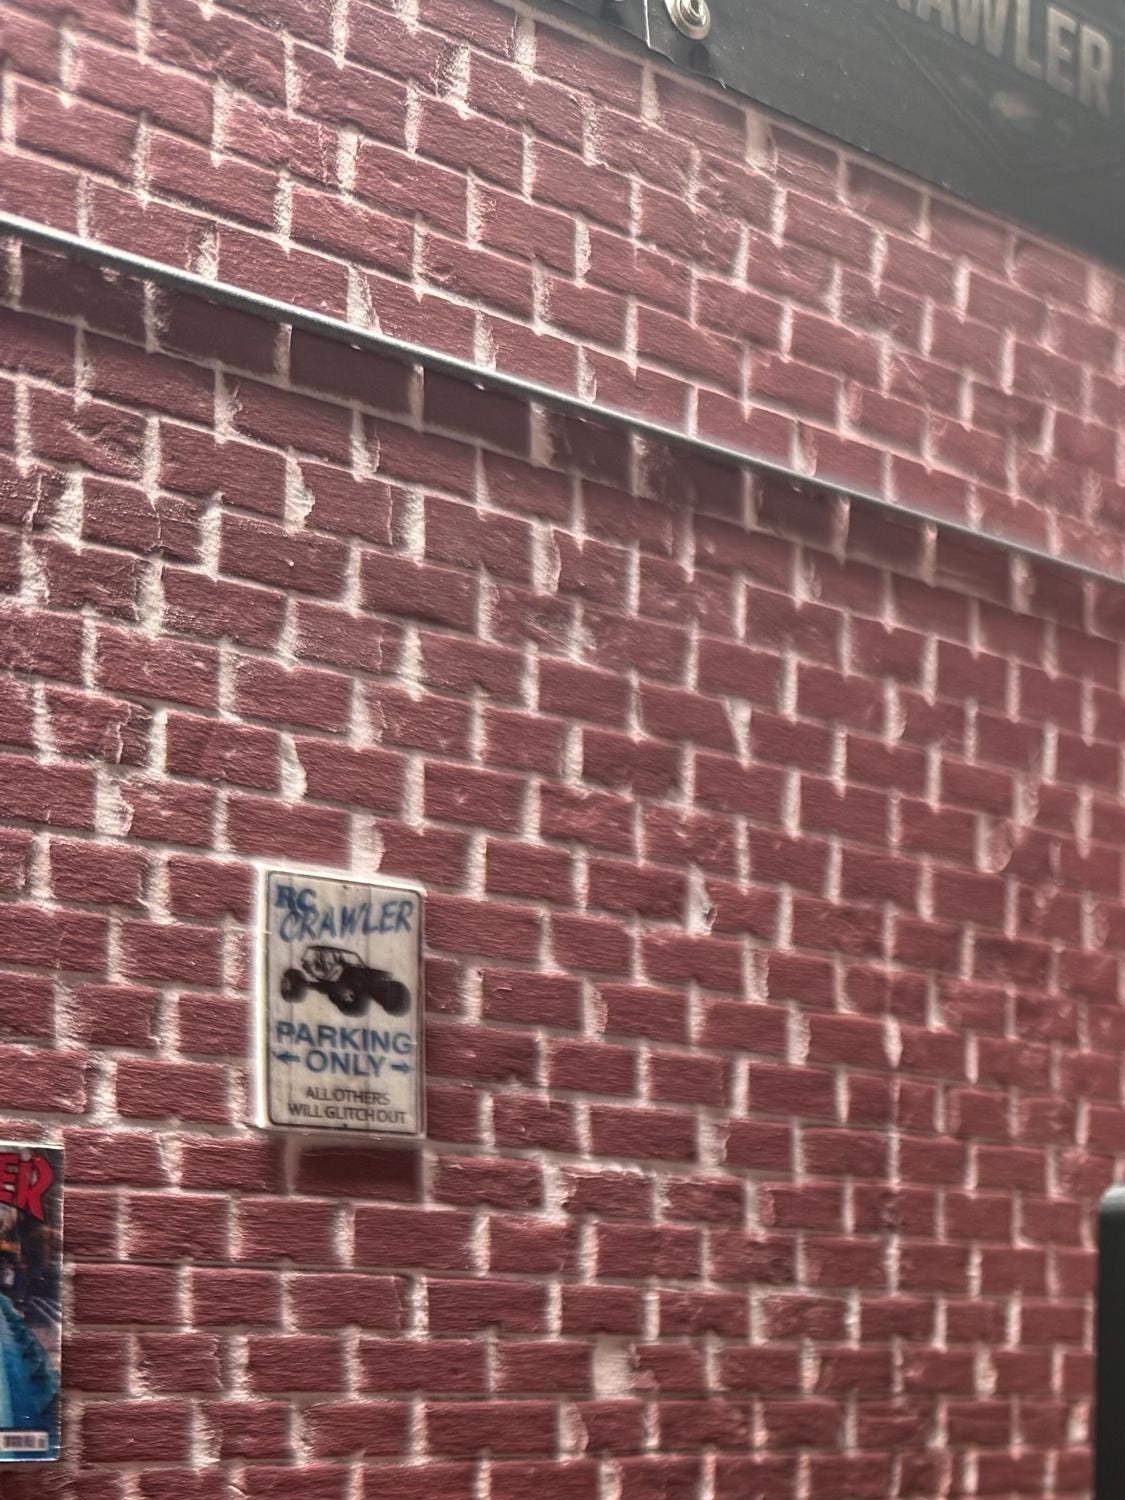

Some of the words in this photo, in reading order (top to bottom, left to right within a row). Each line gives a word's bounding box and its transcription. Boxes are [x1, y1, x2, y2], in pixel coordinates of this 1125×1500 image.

[274, 884, 318, 918] RC
[279, 900, 415, 942] CRAWLER
[276, 1021, 413, 1055] PARKING
[305, 1050, 387, 1078] ONLY
[305, 1086, 332, 1101] ALL
[332, 1088, 391, 1106] OTHERS
[287, 1103, 323, 1118] WILL
[324, 1105, 376, 1121] GLITCH
[376, 1110, 408, 1124] OUT
